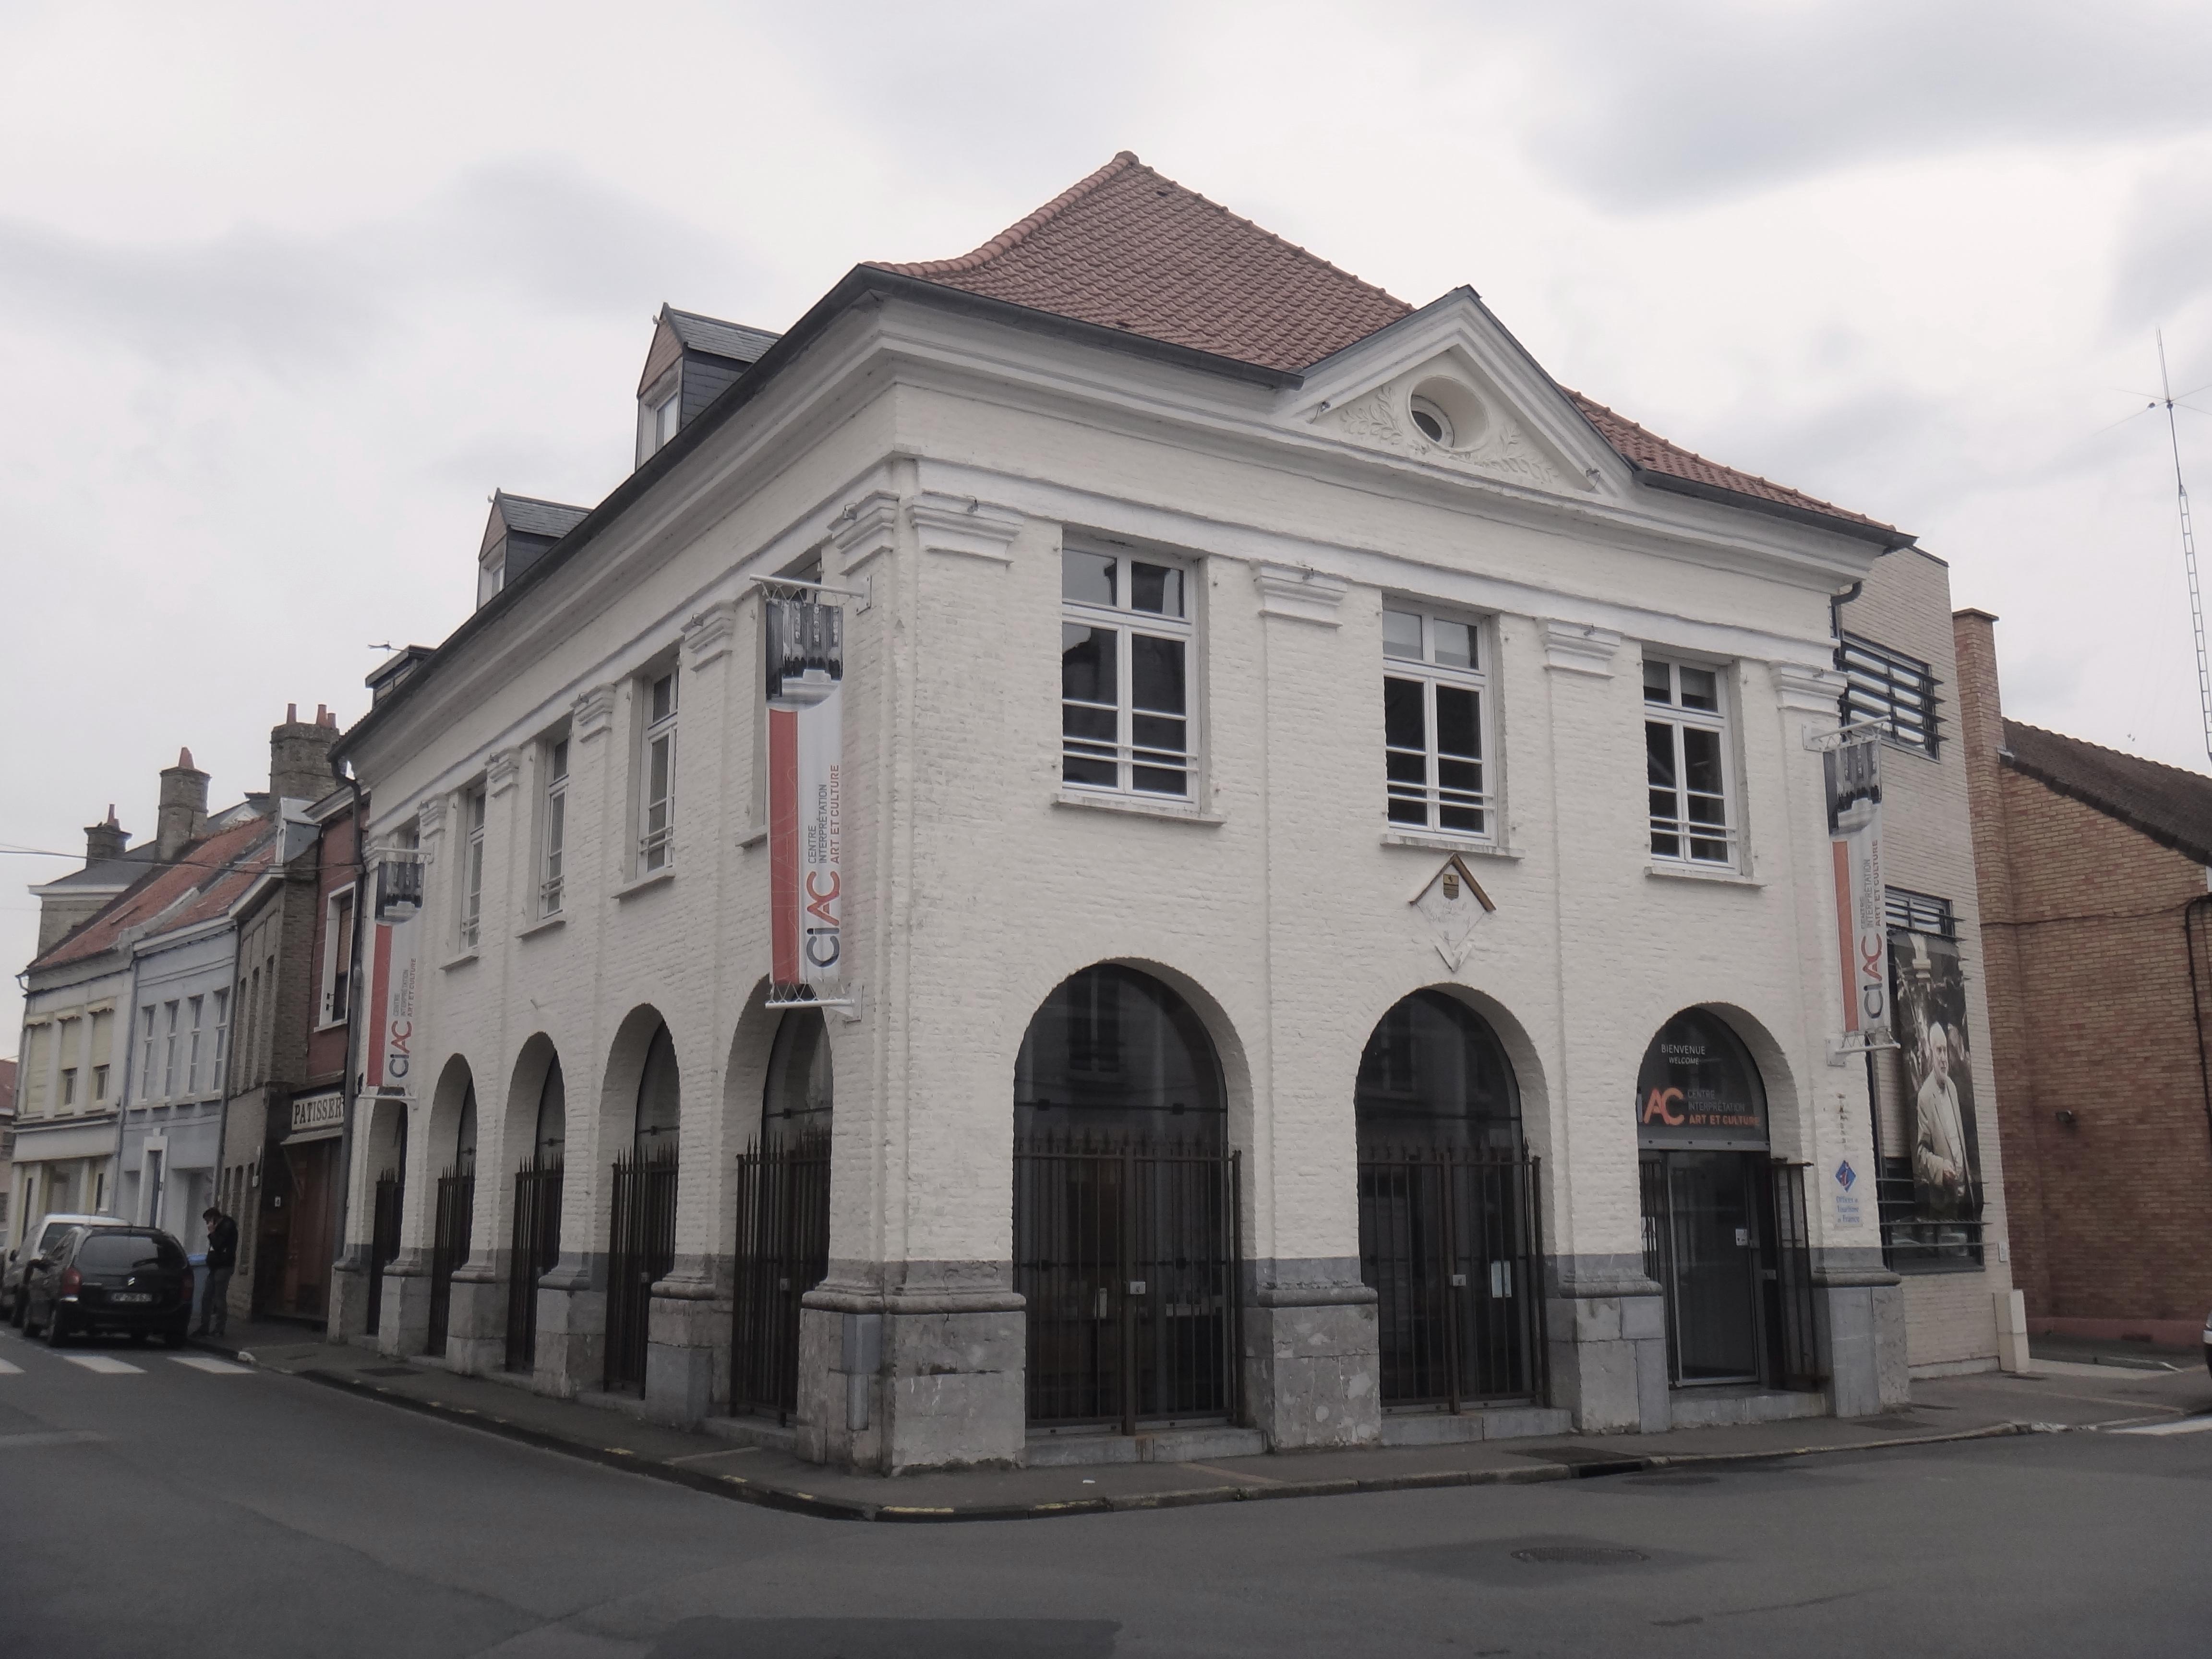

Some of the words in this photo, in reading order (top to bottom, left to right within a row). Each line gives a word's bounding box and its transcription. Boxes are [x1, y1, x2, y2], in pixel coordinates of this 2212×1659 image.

[830, 765, 840, 817] CULTURE
[817, 784, 828, 864] INTERPRÉTATION
[830, 820, 840, 835] ET
[808, 825, 817, 864] CENTRE
[830, 840, 840, 865] ART
[1873, 889, 1880, 902] ET
[409, 991, 414, 1000] ET
[1661, 1044, 1706, 1055] BIENVENUE
[1669, 1057, 1700, 1065] WELCOME
[1687, 1089, 1715, 1099] CENTRE
[294, 1096, 344, 1124] PATISSER
[1689, 1114, 1707, 1124] ART
[1710, 1114, 1720, 1125] ET
